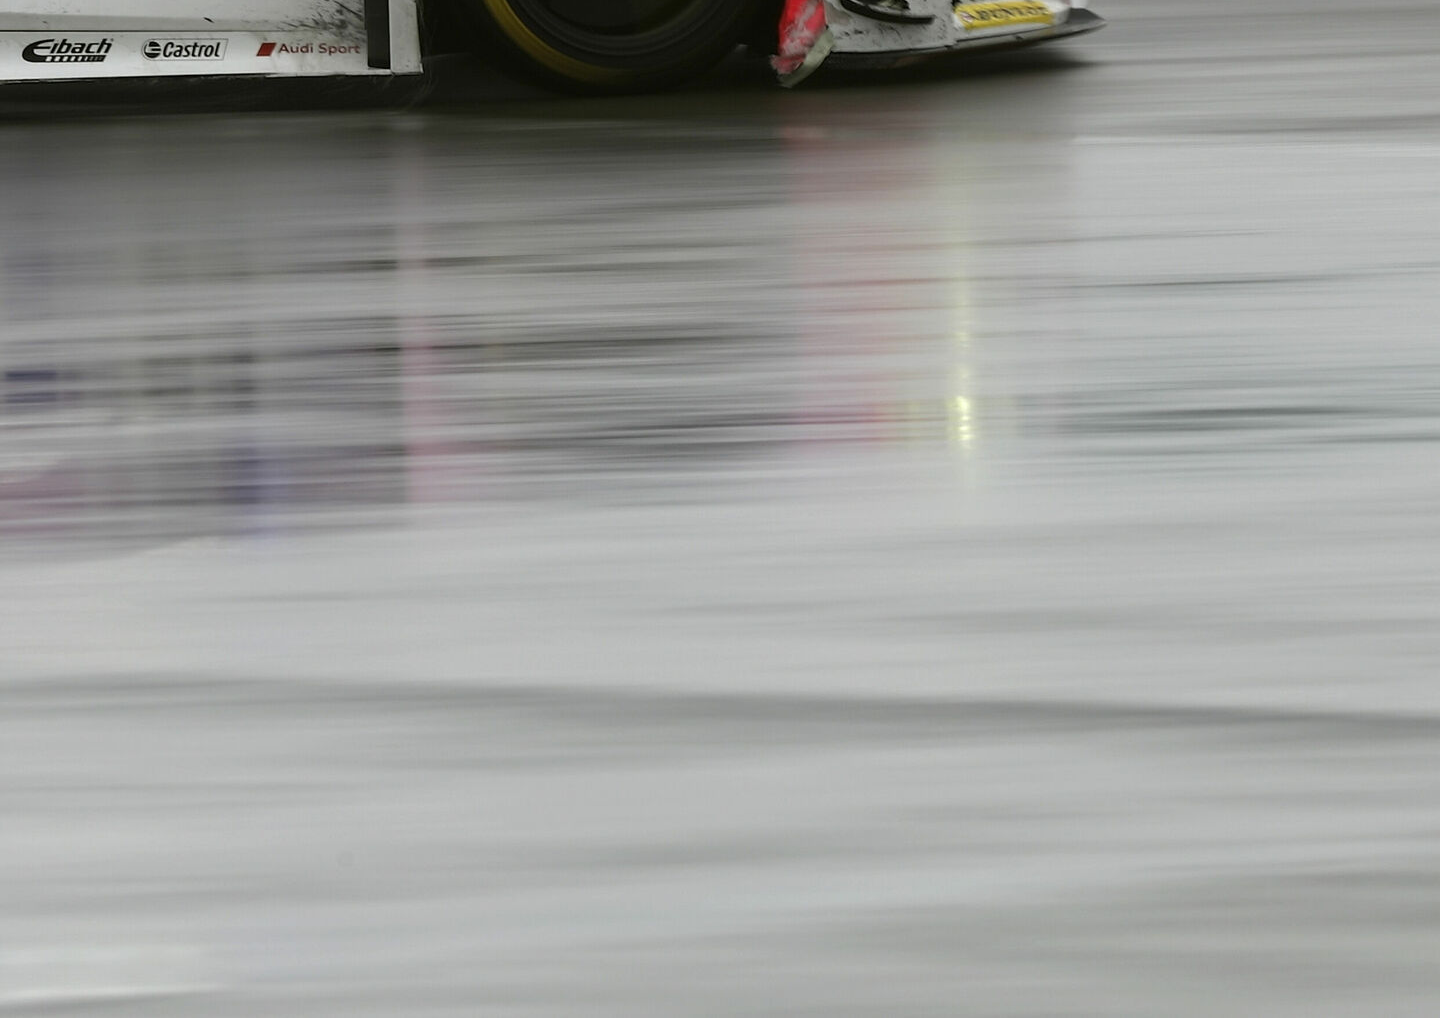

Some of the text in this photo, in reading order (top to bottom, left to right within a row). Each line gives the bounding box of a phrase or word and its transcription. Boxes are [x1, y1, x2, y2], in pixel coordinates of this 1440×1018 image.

[22, 38, 113, 62] Eibach
[163, 42, 221, 58] Castrol
[278, 42, 361, 56] Audi Sport
